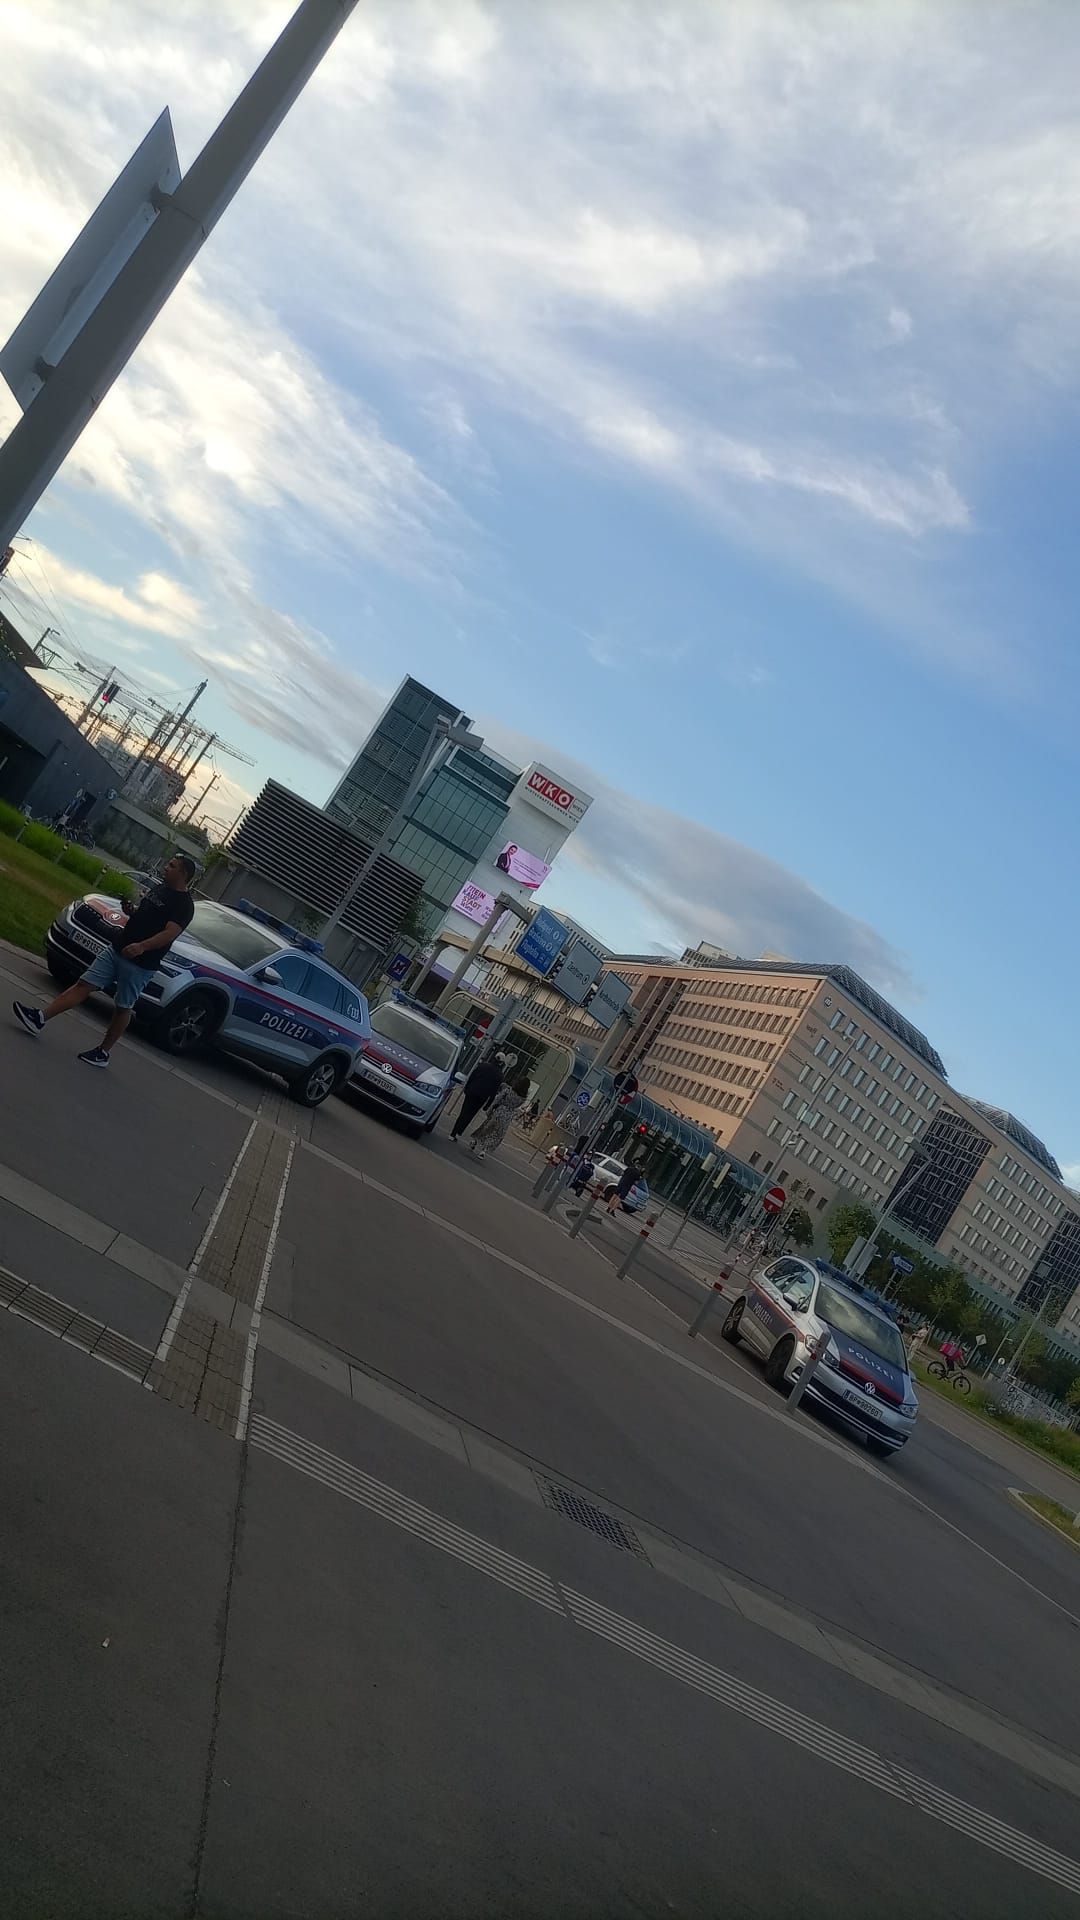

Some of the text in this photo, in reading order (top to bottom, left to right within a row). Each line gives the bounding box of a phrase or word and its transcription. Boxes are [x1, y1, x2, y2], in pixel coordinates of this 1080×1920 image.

[531, 774, 571, 806] WKO
[259, 1012, 308, 1040] POLIZEI
[753, 1301, 771, 1325] POLIZEI
[848, 1347, 894, 1381] POLIZEI
